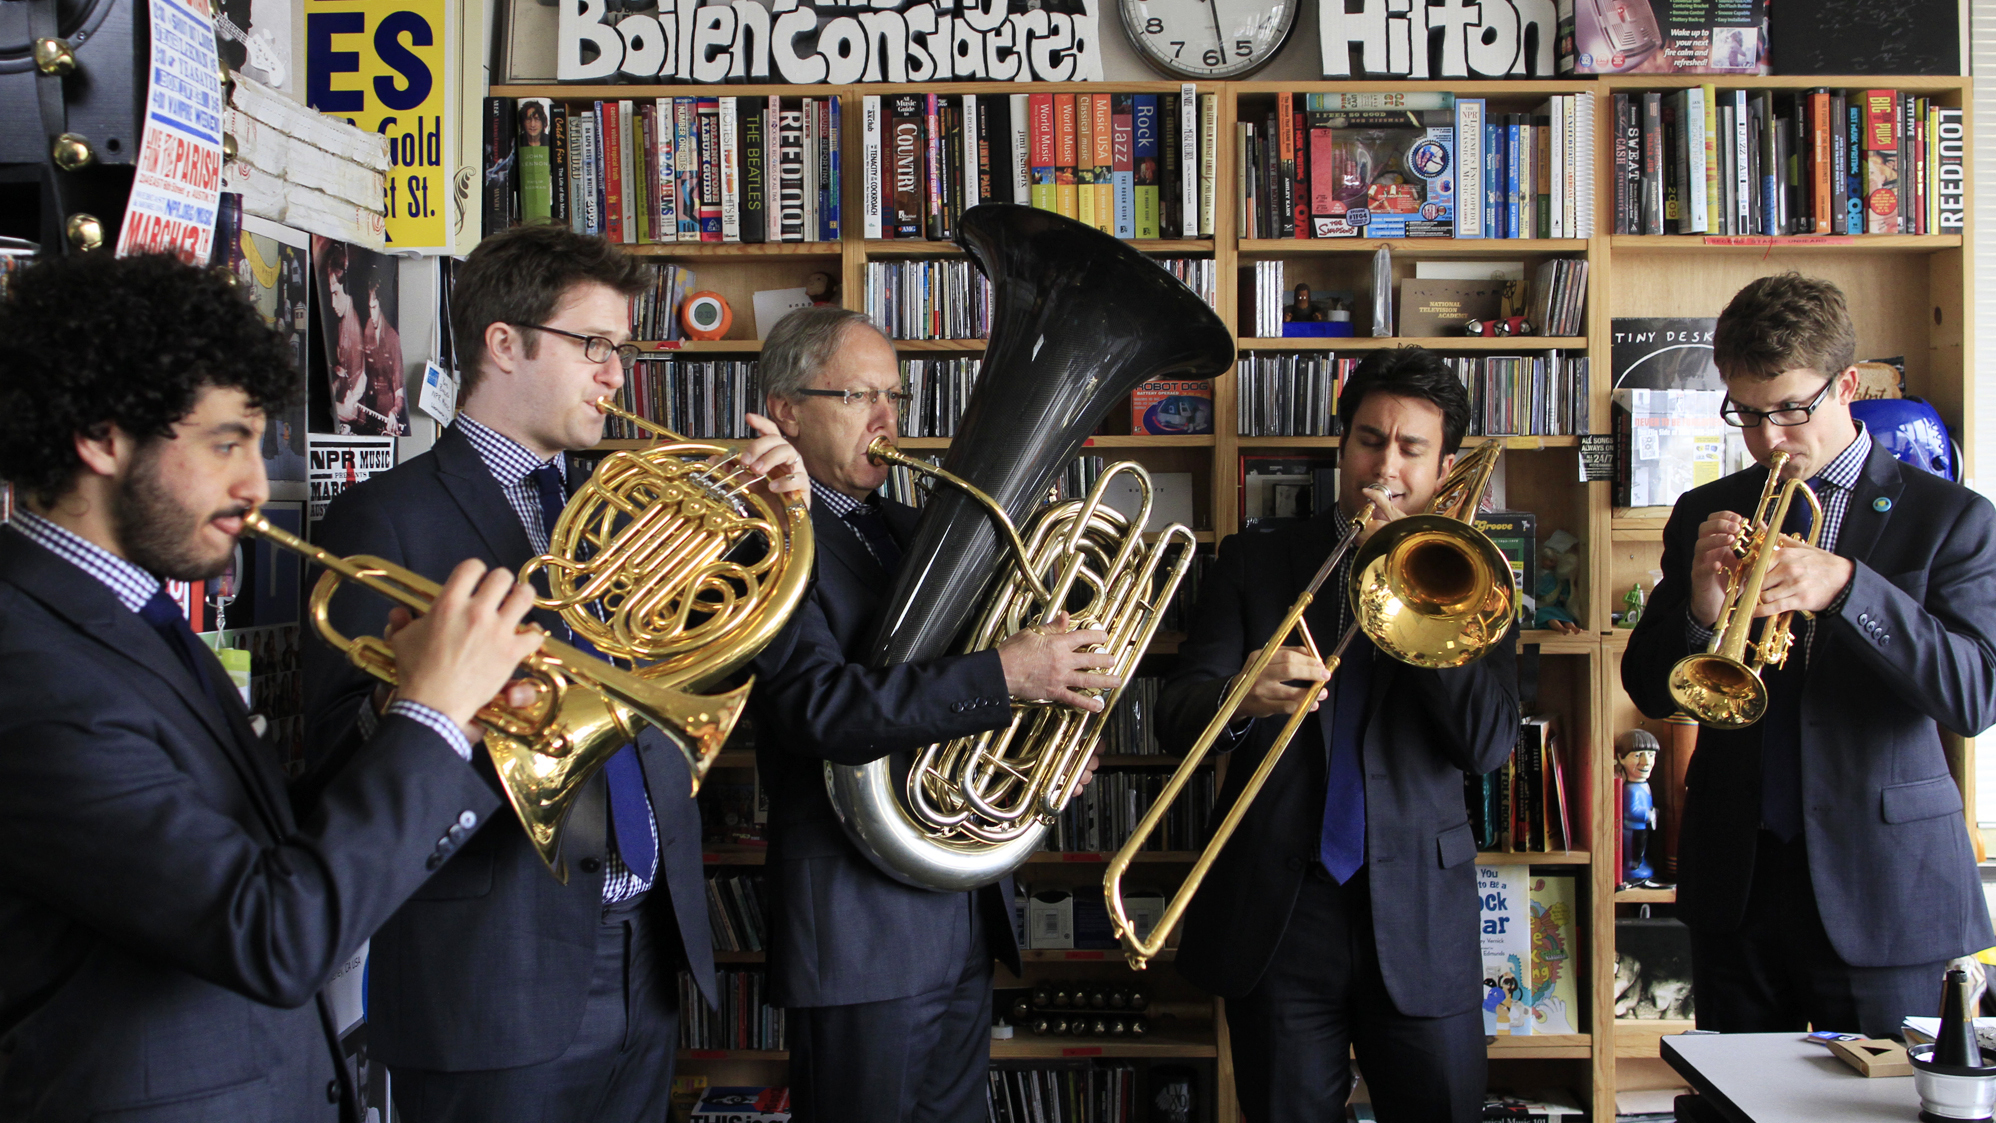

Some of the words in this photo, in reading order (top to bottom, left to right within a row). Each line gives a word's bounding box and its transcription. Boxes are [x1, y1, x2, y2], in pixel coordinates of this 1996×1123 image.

[1145, 18, 1164, 34] 8
[1322, 0, 1558, 79] Hilton
[1671, 29, 1690, 37] Wake
[558, 0, 769, 80] Boilen
[1170, 41, 1189, 58] 7
[1235, 40, 1253, 57] 5
[1664, 48, 1676, 58] fire
[1675, 40, 1692, 48] your
[307, 10, 433, 112] ES
[1202, 49, 1220, 66] 6
[1674, 58, 1708, 68] refreshed!
[1040, 104, 1050, 132] World
[1064, 104, 1072, 132] World
[1080, 97, 1089, 134] Classical
[1096, 100, 1107, 132] Music
[1462, 111, 1478, 119] NPR
[1869, 97, 1891, 113] BIG
[555, 118, 564, 138] Catch
[678, 106, 686, 135] NUMBER
[747, 115, 759, 143] THE
[1137, 106, 1153, 147] Rock
[1874, 123, 1892, 145] PULPS
[1907, 118, 1915, 136] FIVE
[1939, 110, 1963, 157] LOU
[377, 116, 440, 168] Gold
[660, 140, 673, 161] TOP
[702, 116, 710, 161] ALBUM
[710, 116, 718, 164] ROLLING
[780, 111, 804, 179] REED
[1018, 130, 1026, 149] jimi
[1042, 135, 1050, 162] Music
[1064, 135, 1073, 162] Music
[1097, 136, 1108, 158] USA
[1114, 123, 1131, 162] Jazz
[1616, 138, 1626, 165] CASH
[173, 138, 219, 192] PARISH
[556, 148, 564, 164] Fire
[679, 152, 687, 170] HITS
[870, 150, 878, 176] TENACITY
[897, 123, 918, 193] COUNTRY
[979, 139, 990, 171] JIMMY
[1628, 127, 1639, 180] SWEAT
[660, 162, 674, 176] 40
[748, 148, 761, 210] BEATLES
[1020, 152, 1028, 188] hendrix
[703, 164, 712, 202] GUIDE
[981, 174, 991, 198] PAGE
[1470, 167, 1478, 225] ENCYCLOPEDIA
[1939, 164, 1963, 227] REED
[408, 176, 435, 218] St.
[660, 179, 674, 215] ALBUMS
[870, 182, 878, 215] COCKROACH
[1668, 187, 1676, 218] 2009
[586, 199, 595, 228] 2003
[121, 211, 182, 258] MARCH
[1616, 331, 1656, 343] TINY
[1667, 331, 1715, 343] DESK
[1181, 382, 1209, 391] DOG
[1635, 418, 1659, 427] NEVER
[1661, 418, 1670, 427] TO
[1672, 418, 1681, 427] BE
[1659, 428, 1670, 436] Side
[310, 450, 356, 470] NPR
[360, 450, 390, 469] MUSIC
[1593, 454, 1614, 463] 24/7
[310, 481, 356, 501] MARC
[1475, 520, 1513, 532] Groove
[1502, 773, 1510, 800] FOLK
[1502, 804, 1510, 834] ROCK
[1479, 881, 1487, 889] to
[1490, 880, 1499, 889] Be
[1480, 868, 1498, 878] You
